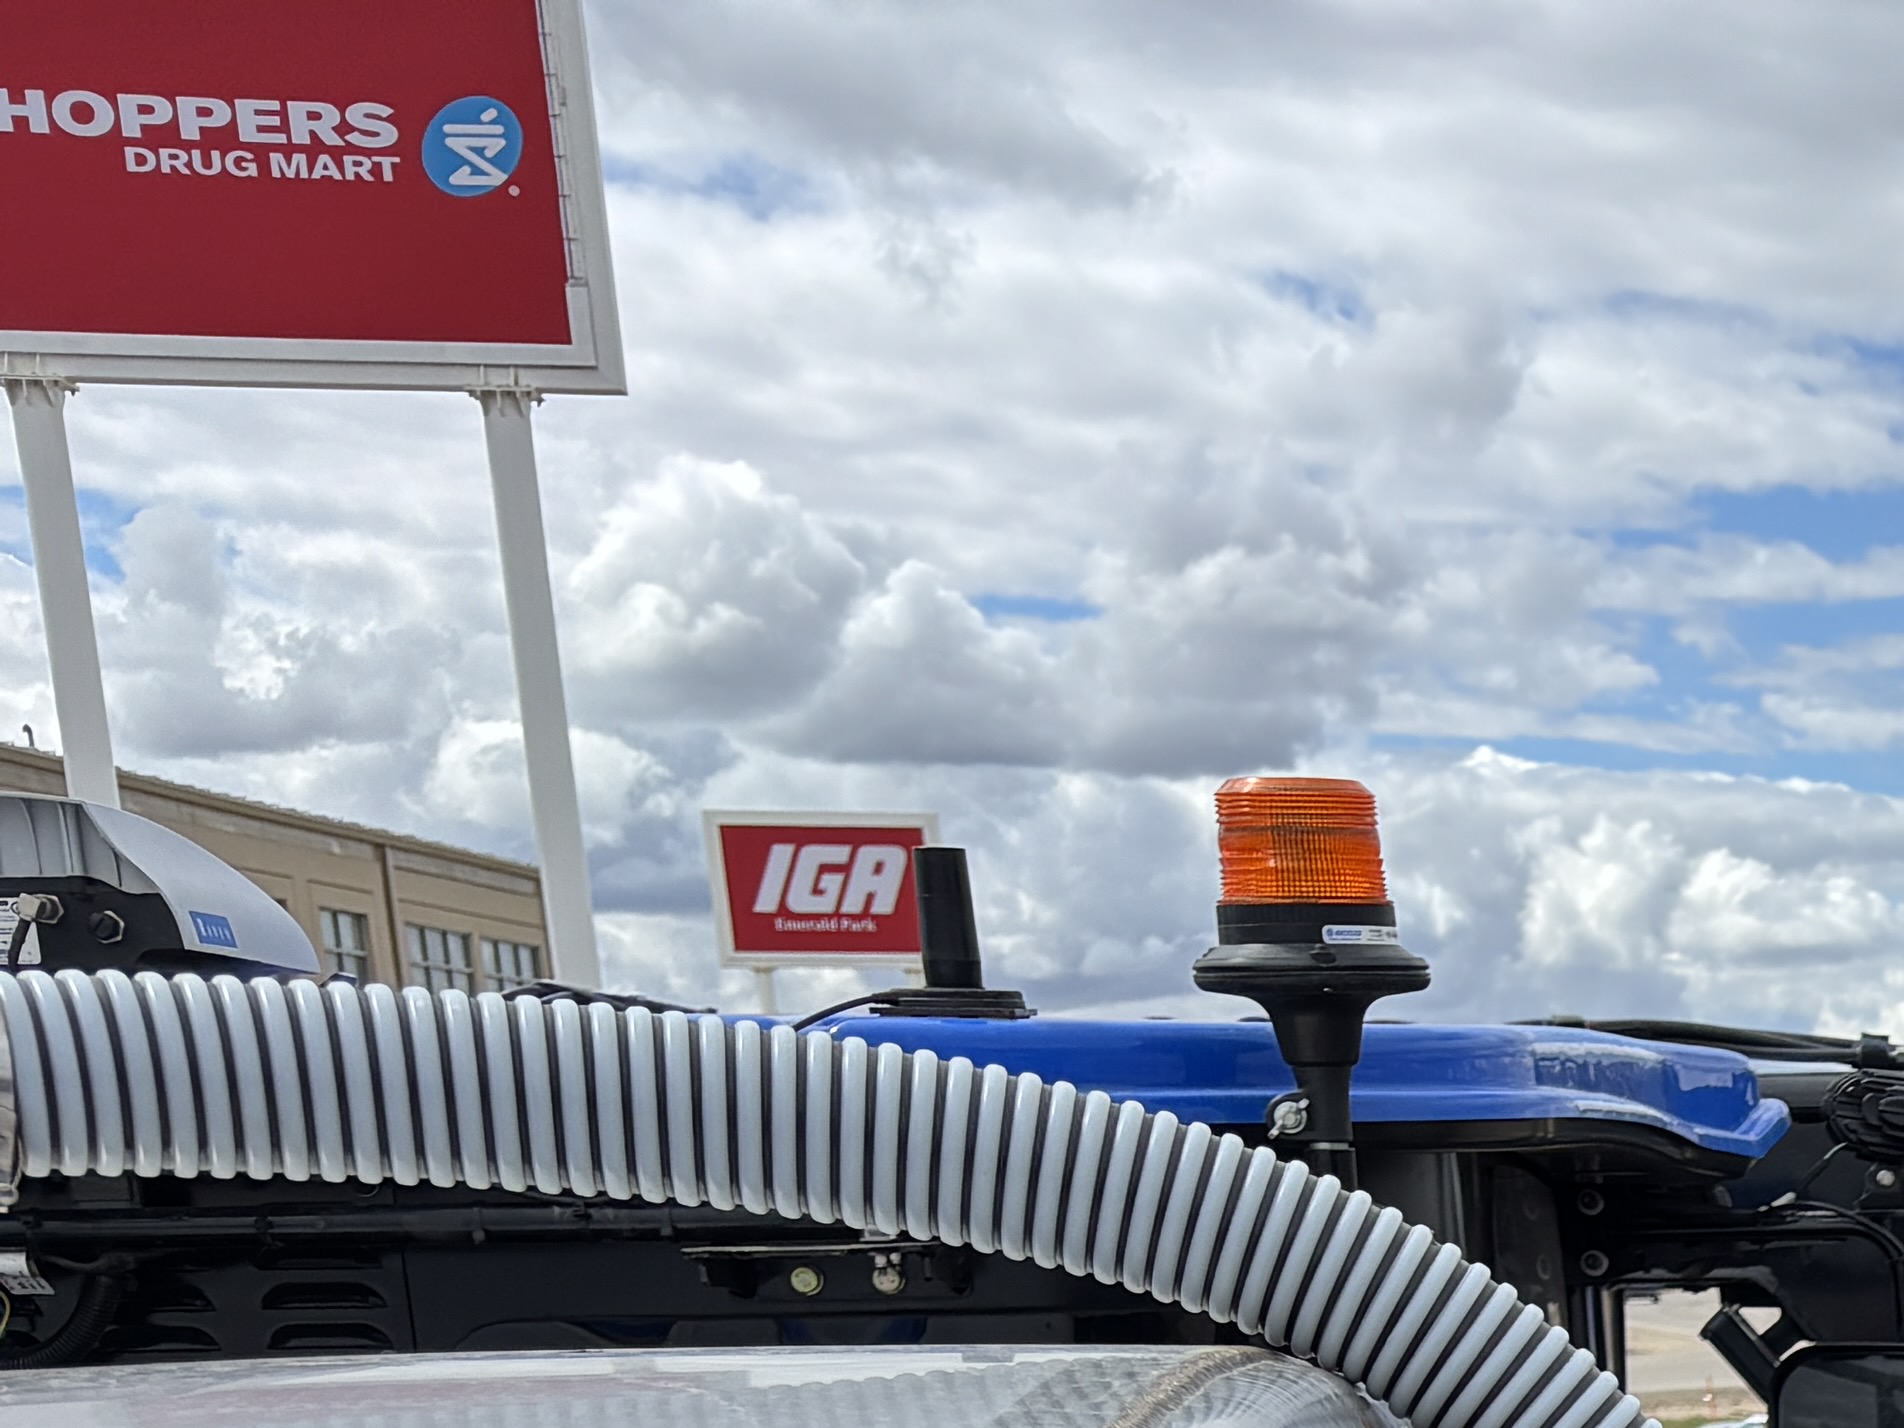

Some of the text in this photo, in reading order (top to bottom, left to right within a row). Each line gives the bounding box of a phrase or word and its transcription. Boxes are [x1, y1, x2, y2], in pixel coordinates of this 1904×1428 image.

[124, 146, 400, 182] DRUG MART
[752, 843, 908, 915] IGA
